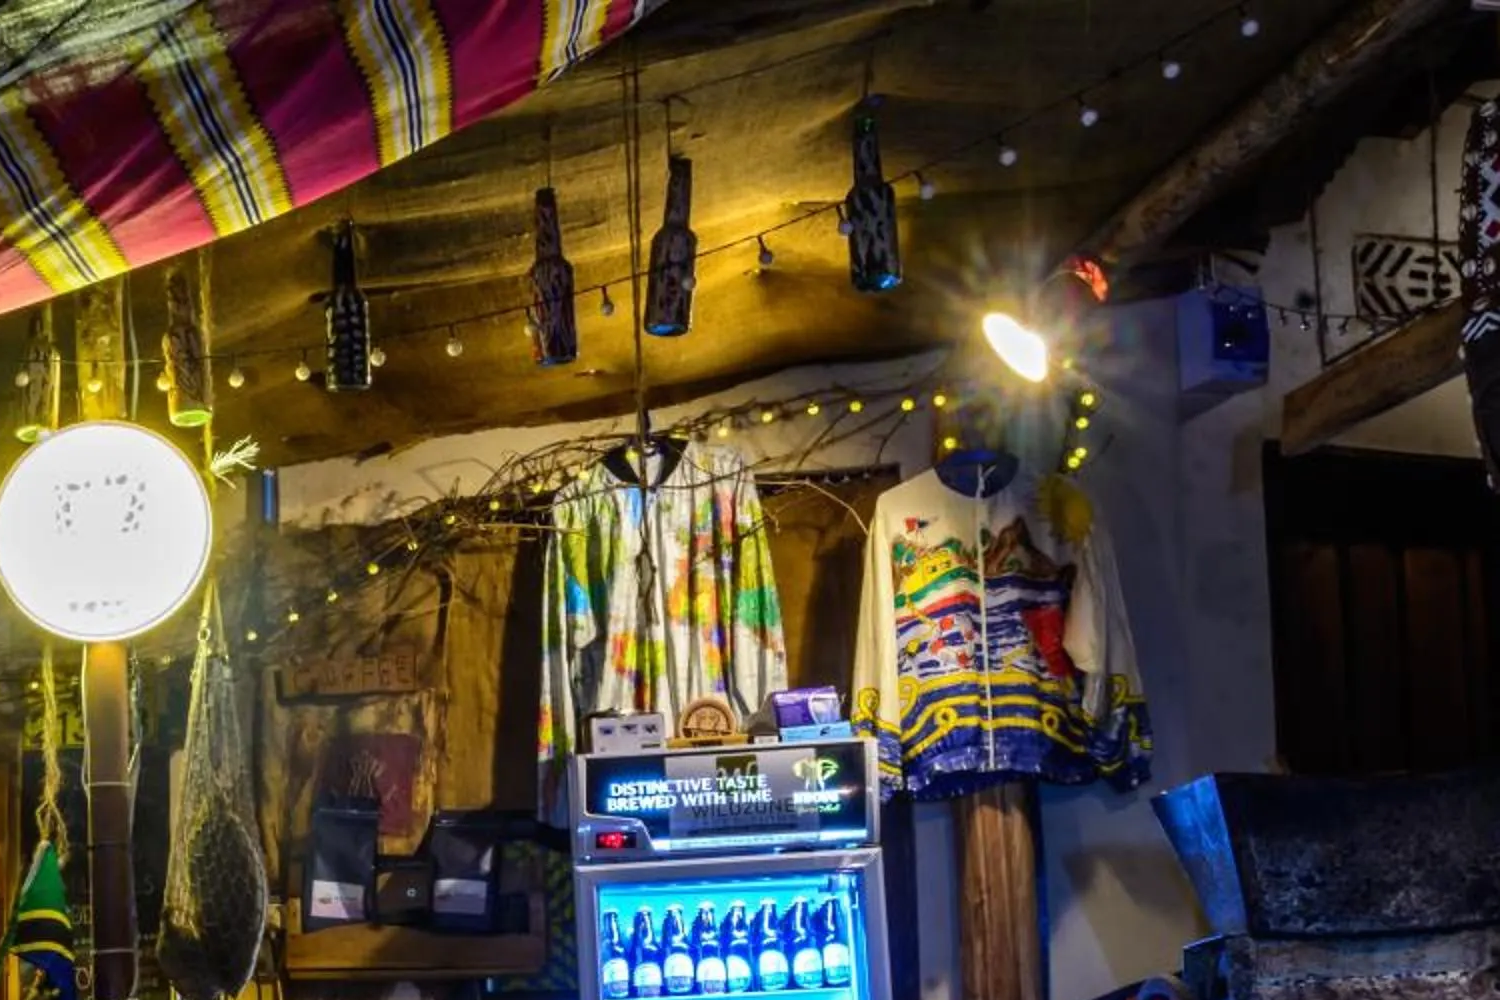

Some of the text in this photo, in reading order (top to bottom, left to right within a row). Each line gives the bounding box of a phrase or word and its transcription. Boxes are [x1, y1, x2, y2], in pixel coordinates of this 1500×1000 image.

[610, 774, 768, 797] DISTINCTIVE TASTE
[607, 794, 677, 812] BREWED
[682, 790, 727, 807] WITH
[733, 788, 773, 804] TIME
